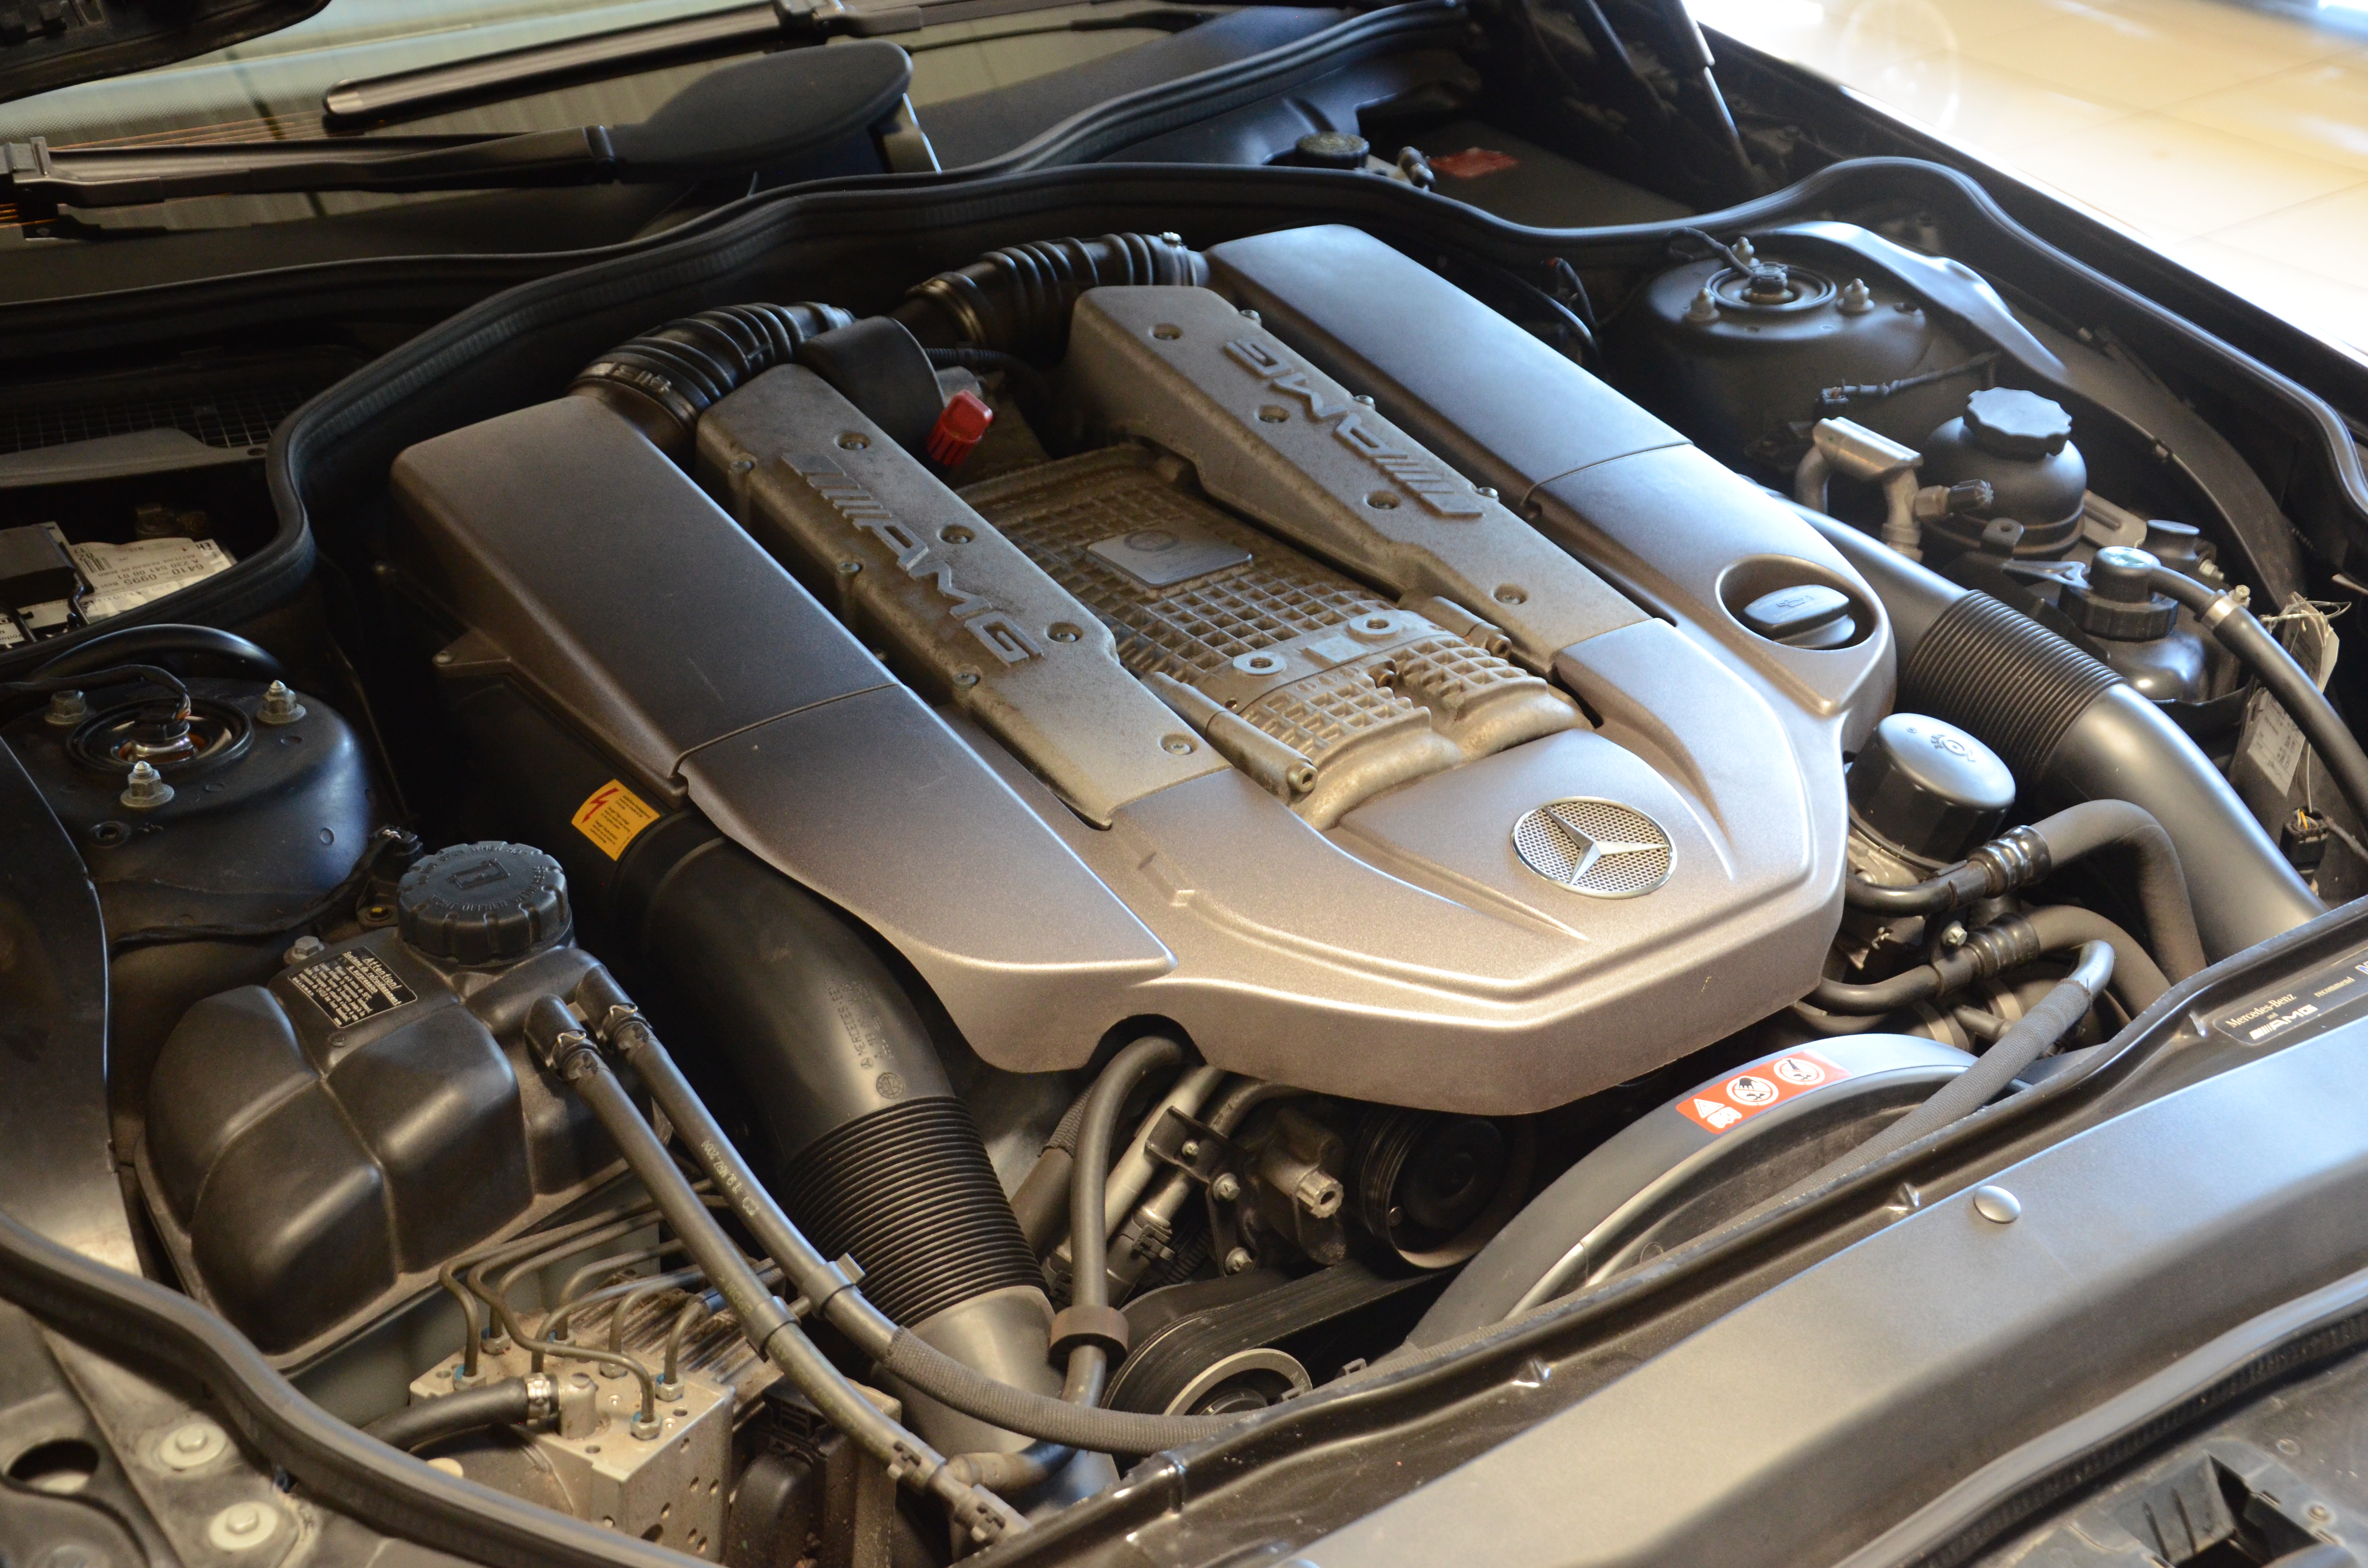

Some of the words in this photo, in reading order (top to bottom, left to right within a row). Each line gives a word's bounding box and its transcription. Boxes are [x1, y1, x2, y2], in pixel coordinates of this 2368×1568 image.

[1225, 337, 1408, 460] AMG
[123, 574, 157, 584] 0995
[172, 563, 203, 575] 6410
[351, 969, 379, 993] surpression
[361, 964, 370, 973] de
[367, 971, 403, 1005] refroidissement
[364, 957, 402, 989] Attention!
[2226, 993, 2297, 1028] Mercedes-Benz
[2314, 977, 2355, 997] recommend
[2269, 1004, 2318, 1031] AMG
